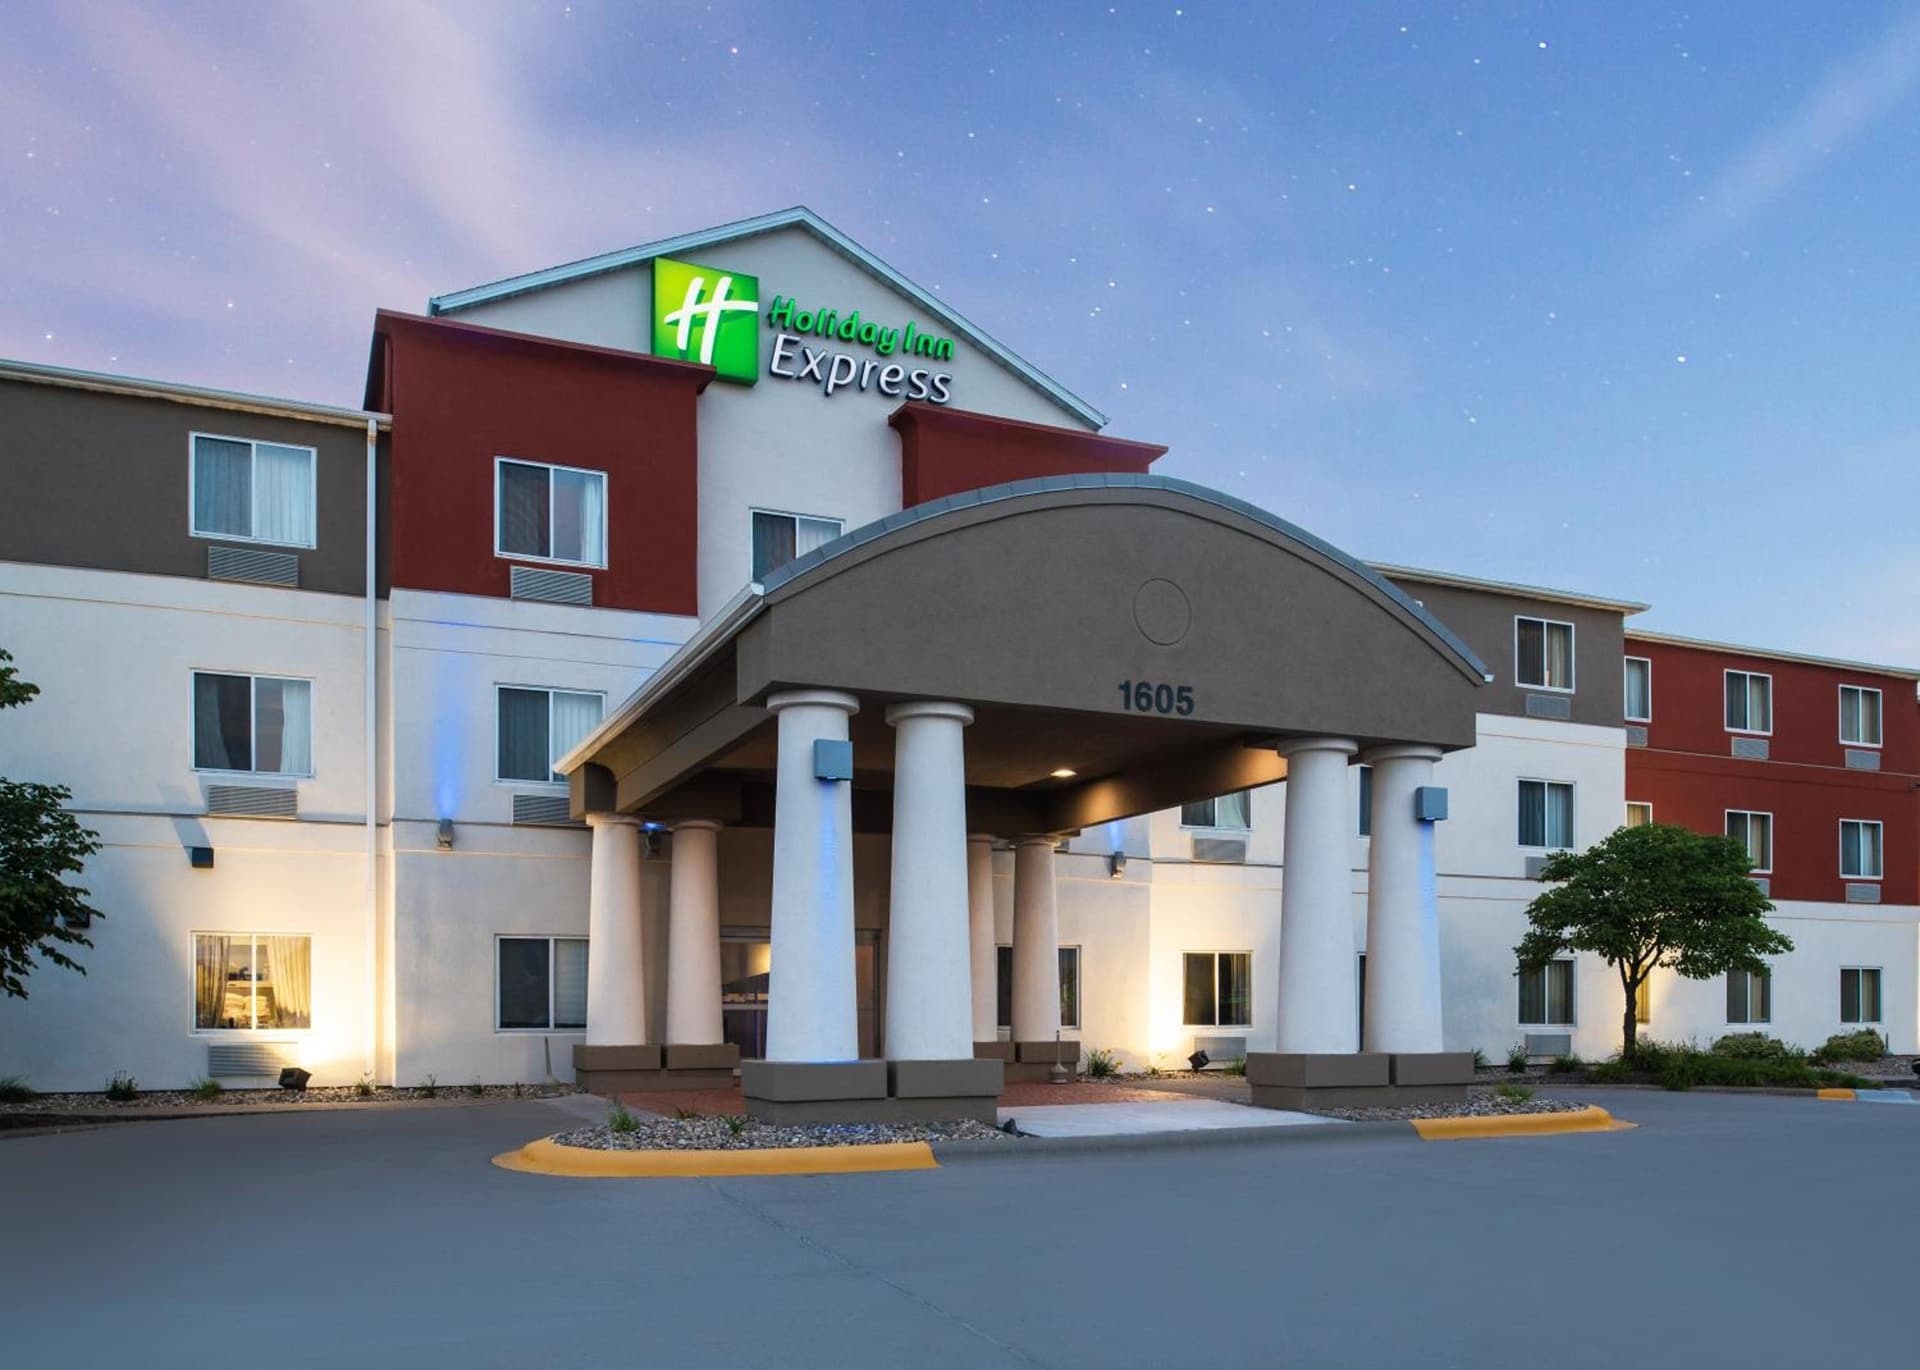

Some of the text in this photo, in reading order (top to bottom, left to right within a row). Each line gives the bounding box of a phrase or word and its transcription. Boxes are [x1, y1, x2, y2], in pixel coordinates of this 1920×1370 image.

[768, 295, 955, 360] Holiday Inn
[769, 333, 953, 405] Express
[1118, 680, 1194, 716] 1605
